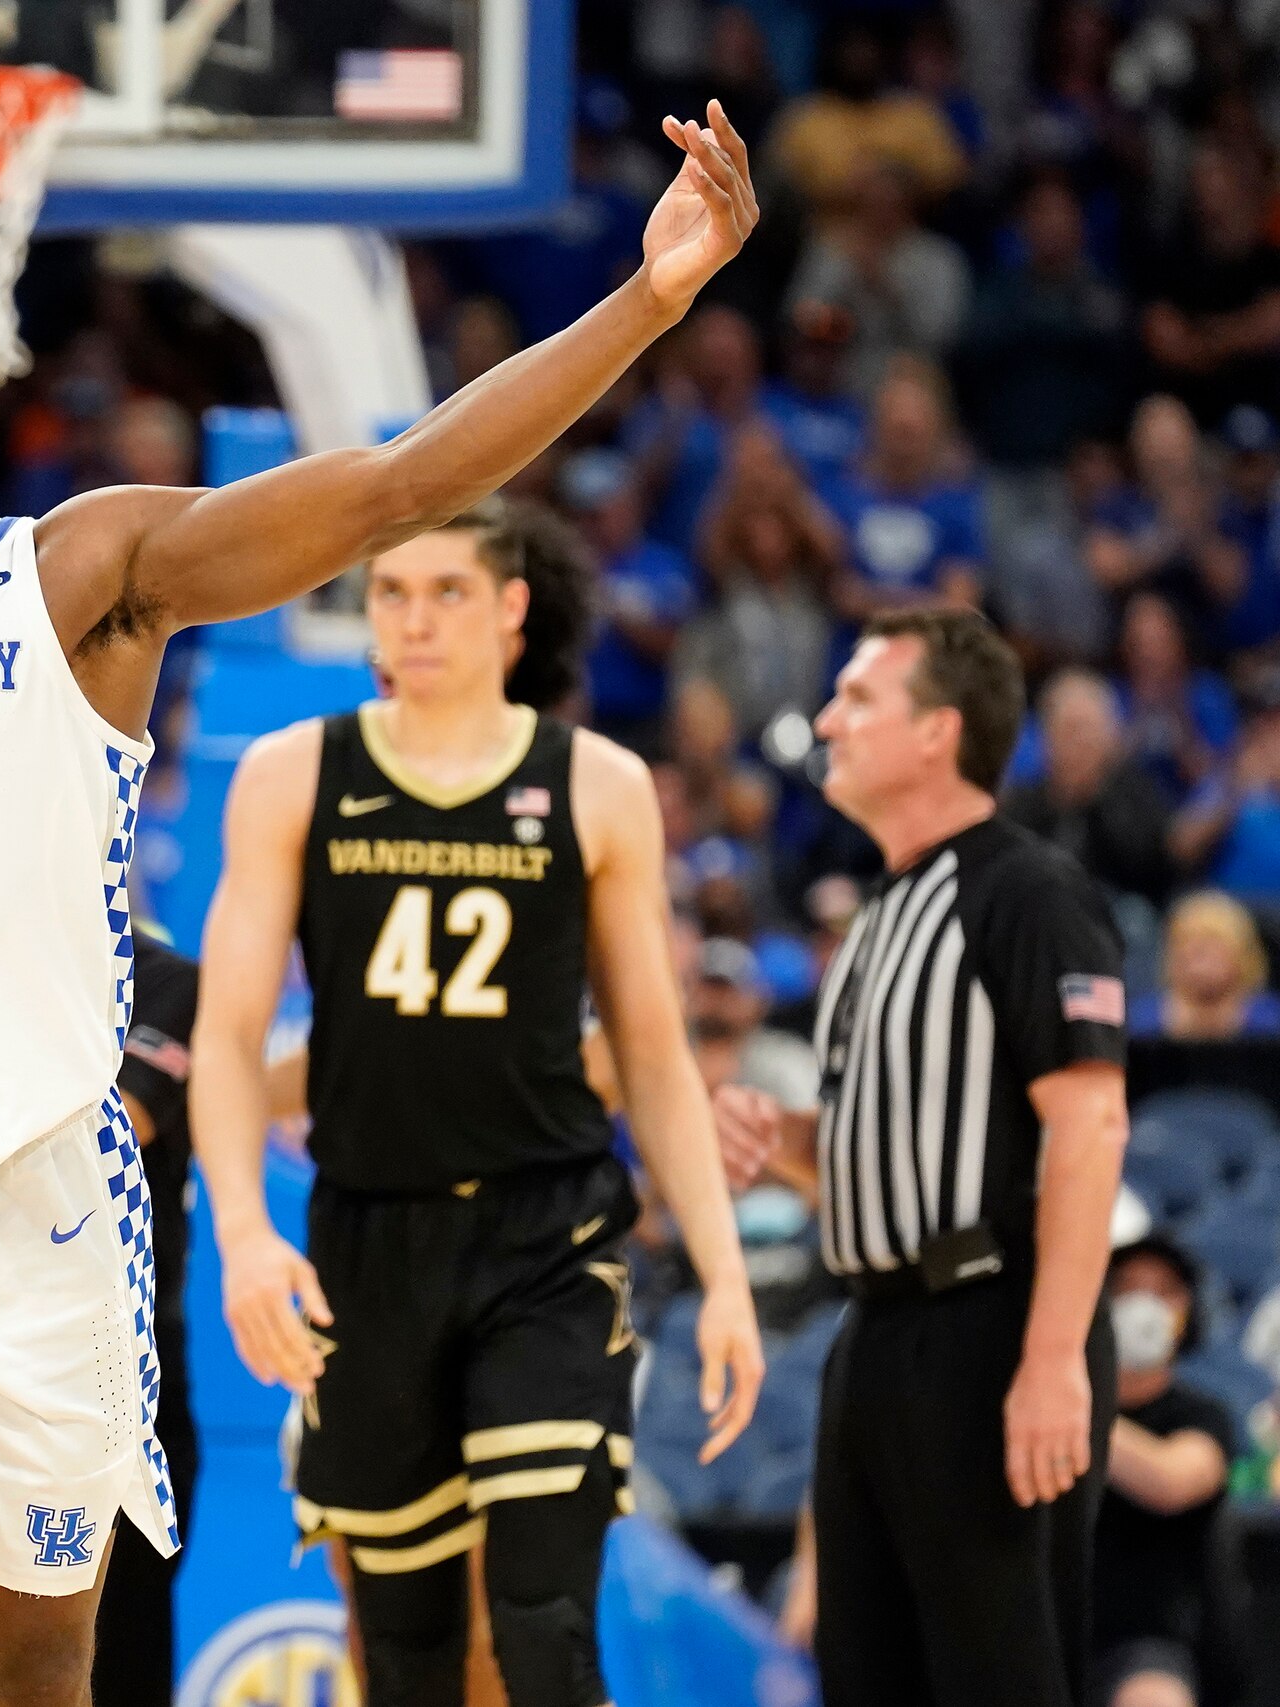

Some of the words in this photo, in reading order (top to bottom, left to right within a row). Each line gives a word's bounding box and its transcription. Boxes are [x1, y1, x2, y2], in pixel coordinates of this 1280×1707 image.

[327, 838, 553, 882] VANDERBILT
[363, 884, 513, 1018] 42
[26, 1504, 97, 1566] UK
